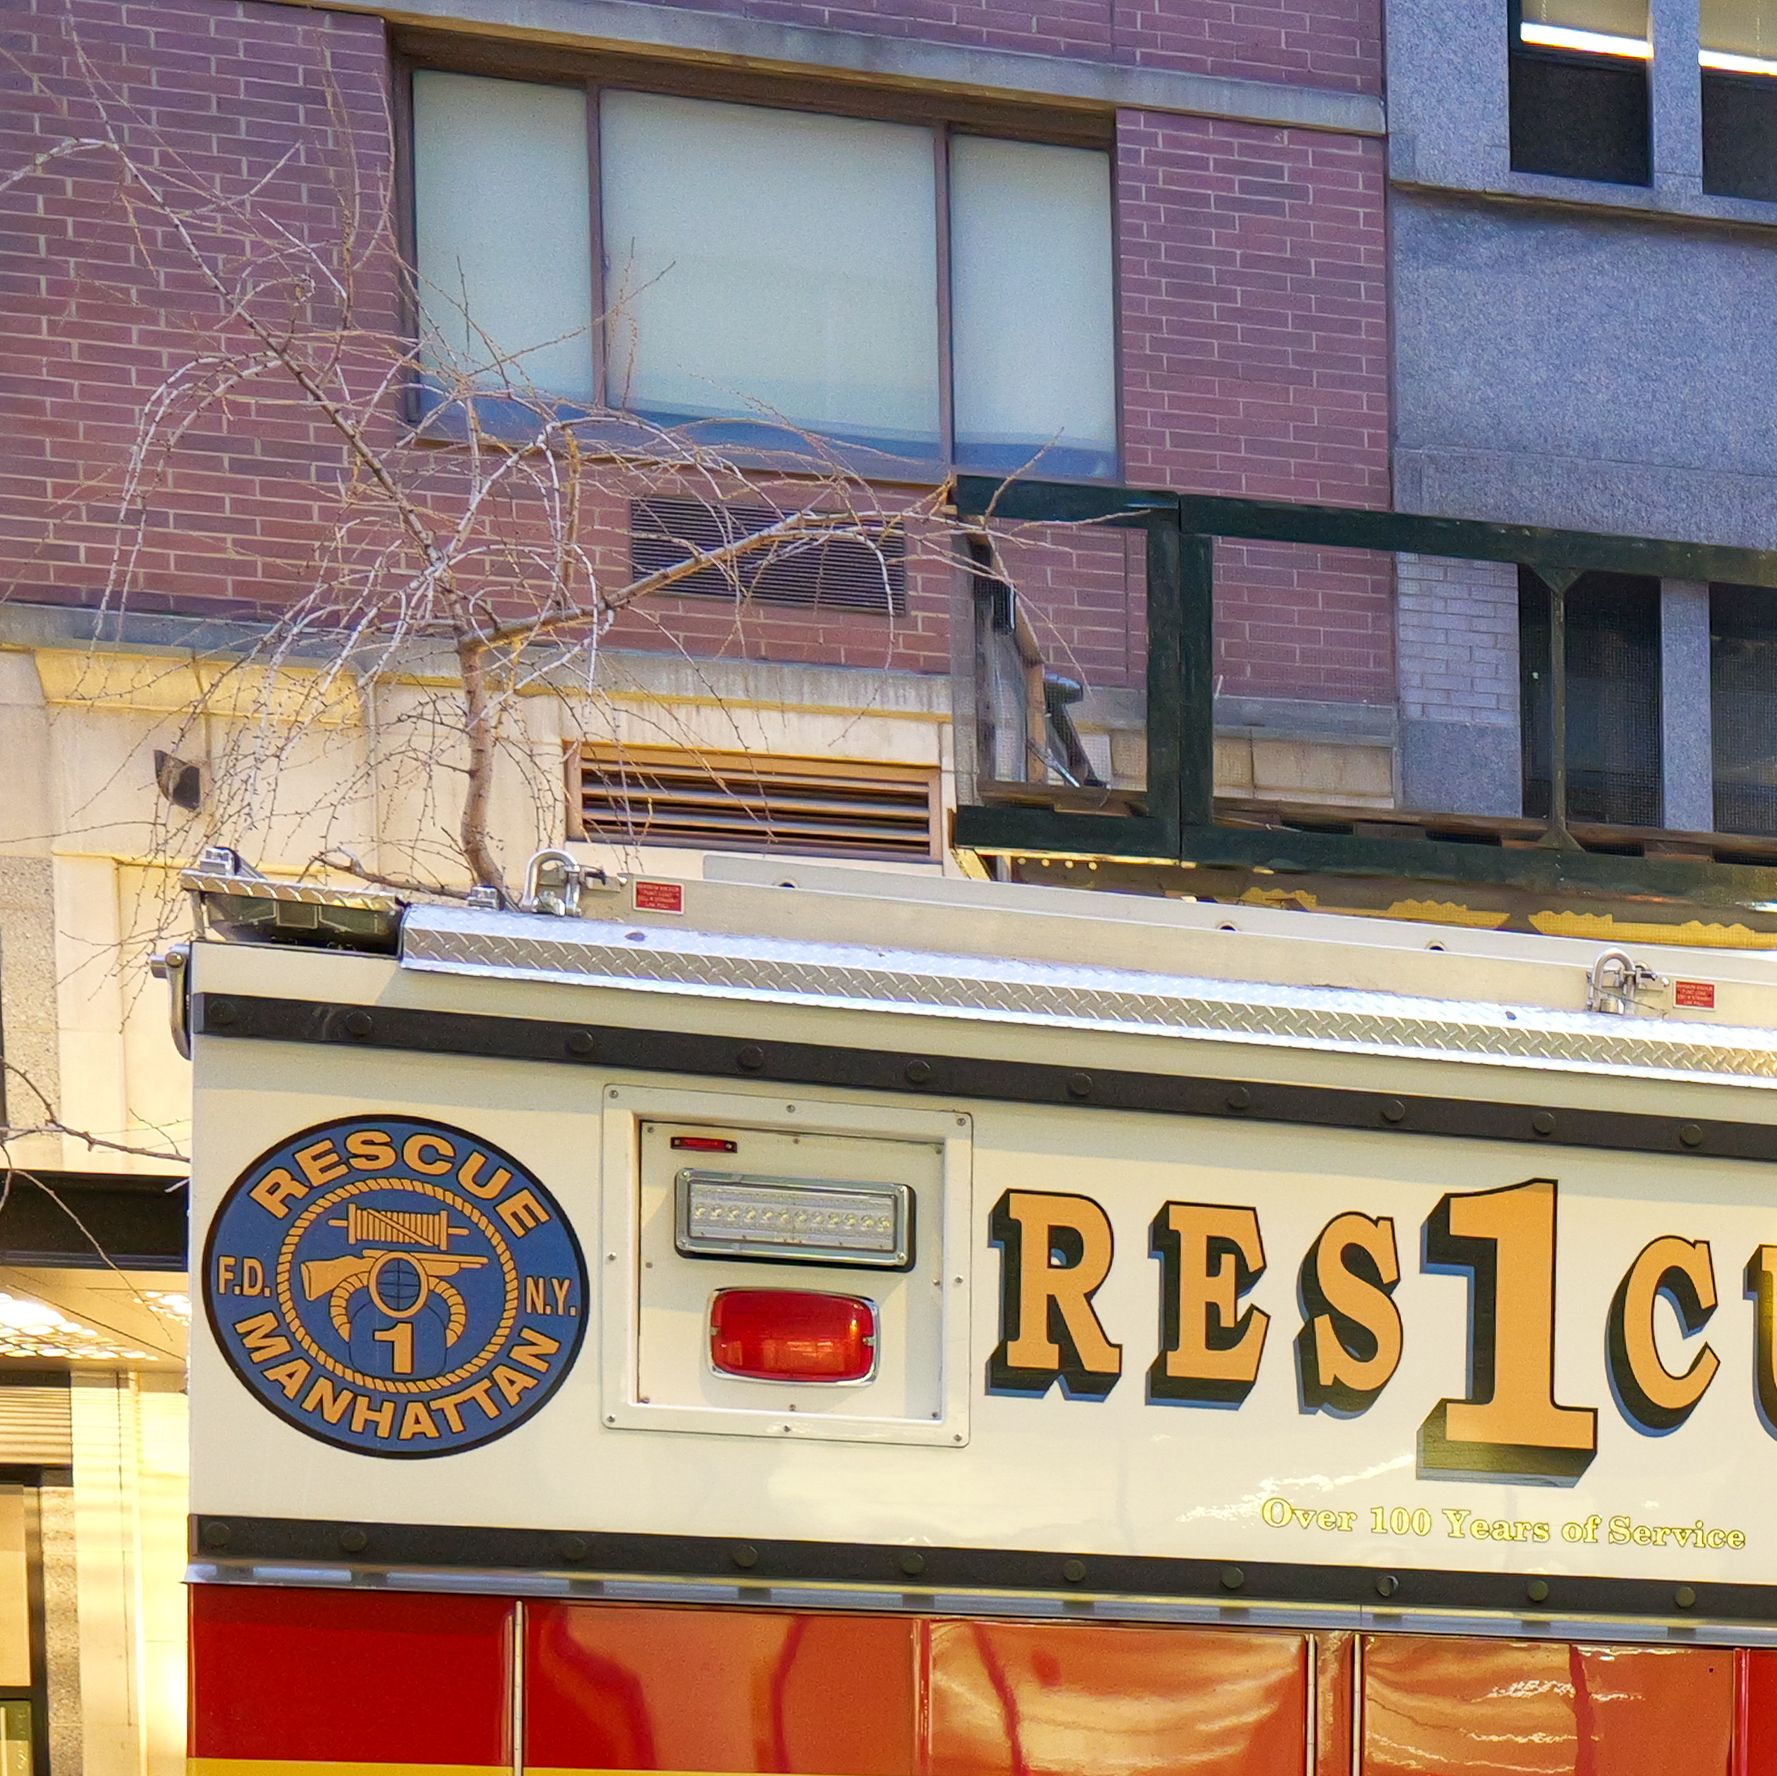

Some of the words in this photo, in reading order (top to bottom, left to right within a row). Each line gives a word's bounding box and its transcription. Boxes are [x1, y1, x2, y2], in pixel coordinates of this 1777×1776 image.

[249, 1130, 551, 1239] RESCUE
[216, 1253, 272, 1298] F.D.
[524, 1275, 578, 1317] N.Y.
[233, 1310, 562, 1441] MANHATTAN
[373, 1321, 414, 1375] 1
[1260, 1496, 1357, 1534] Over
[1370, 1505, 1433, 1537] 100
[1442, 1508, 1551, 1544] Years
[1560, 1514, 1603, 1545] of
[1608, 1515, 1747, 1551] Service
